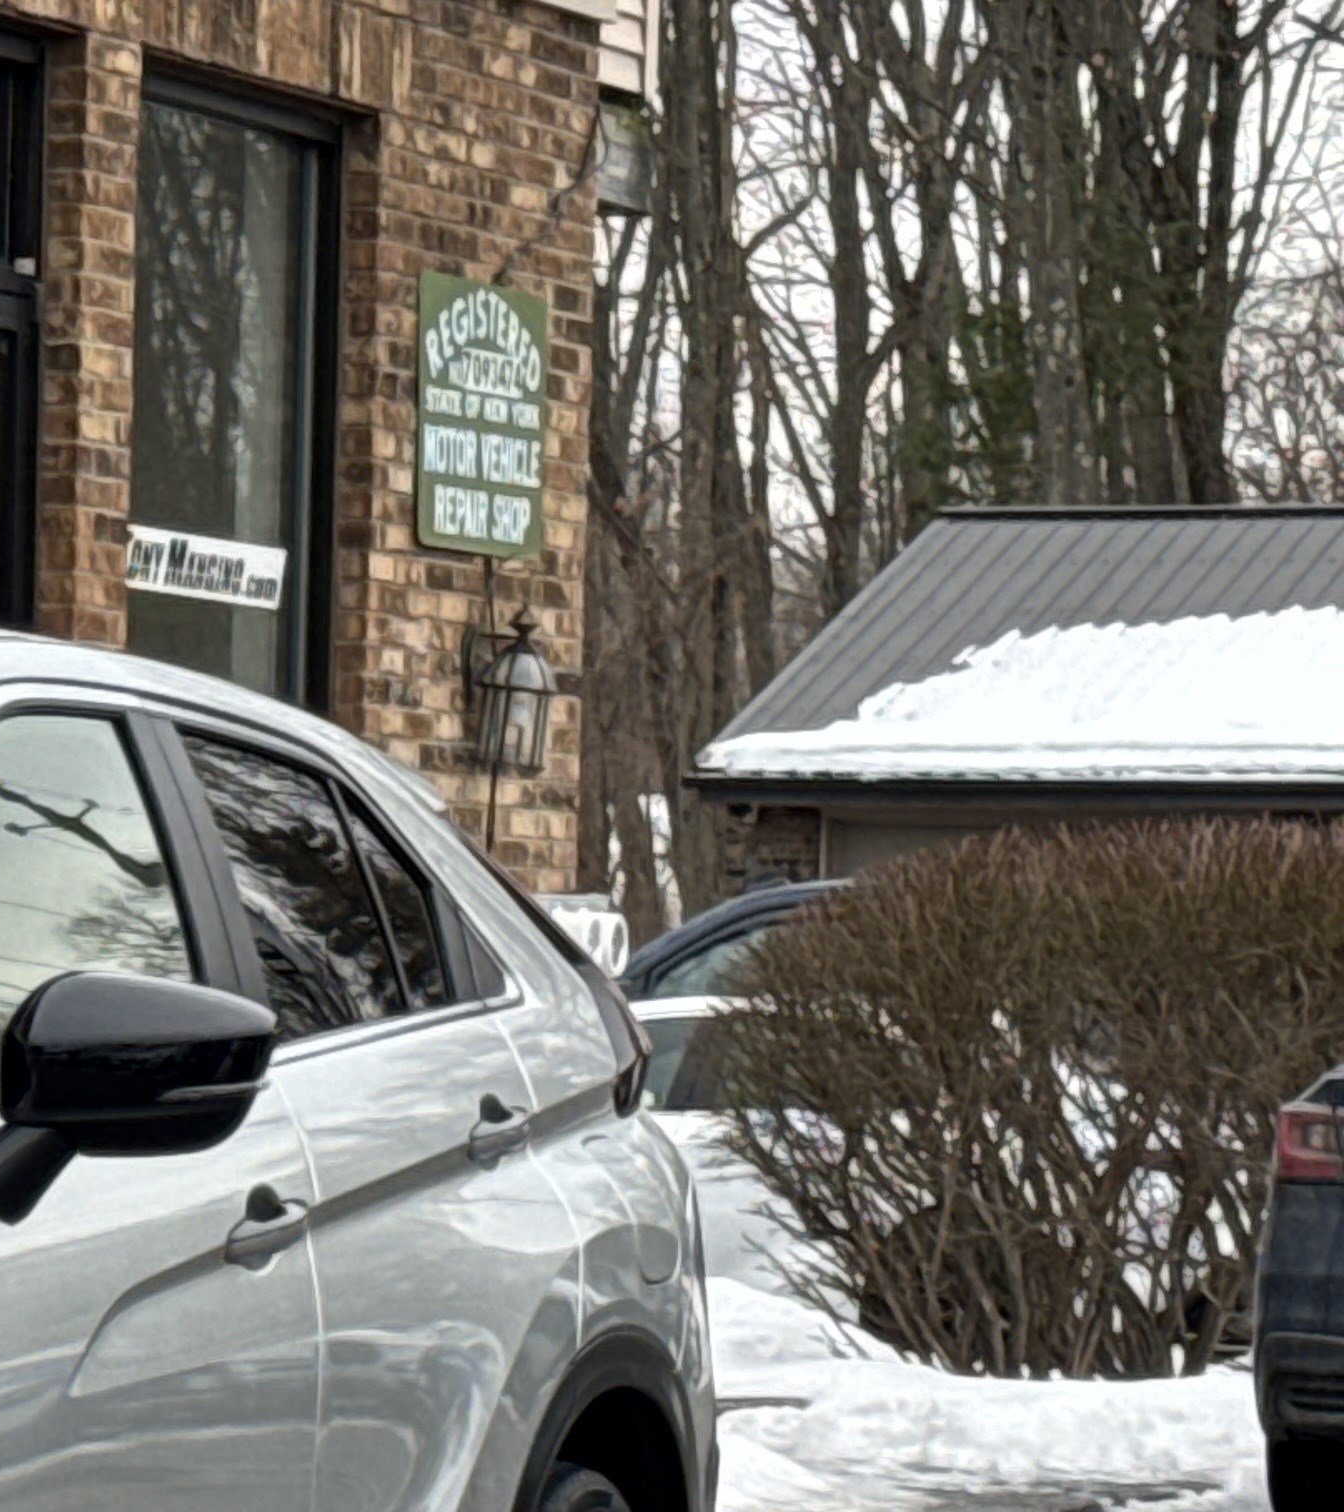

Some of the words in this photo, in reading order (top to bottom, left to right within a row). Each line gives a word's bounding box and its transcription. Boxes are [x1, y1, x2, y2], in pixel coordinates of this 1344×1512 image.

[424, 287, 541, 393] REGISTERED
[423, 423, 477, 479] MOTOR
[480, 432, 542, 489] VEHICLE
[433, 483, 489, 539] REPAIR
[492, 493, 531, 545] SHOP
[127, 538, 165, 585] ONY
